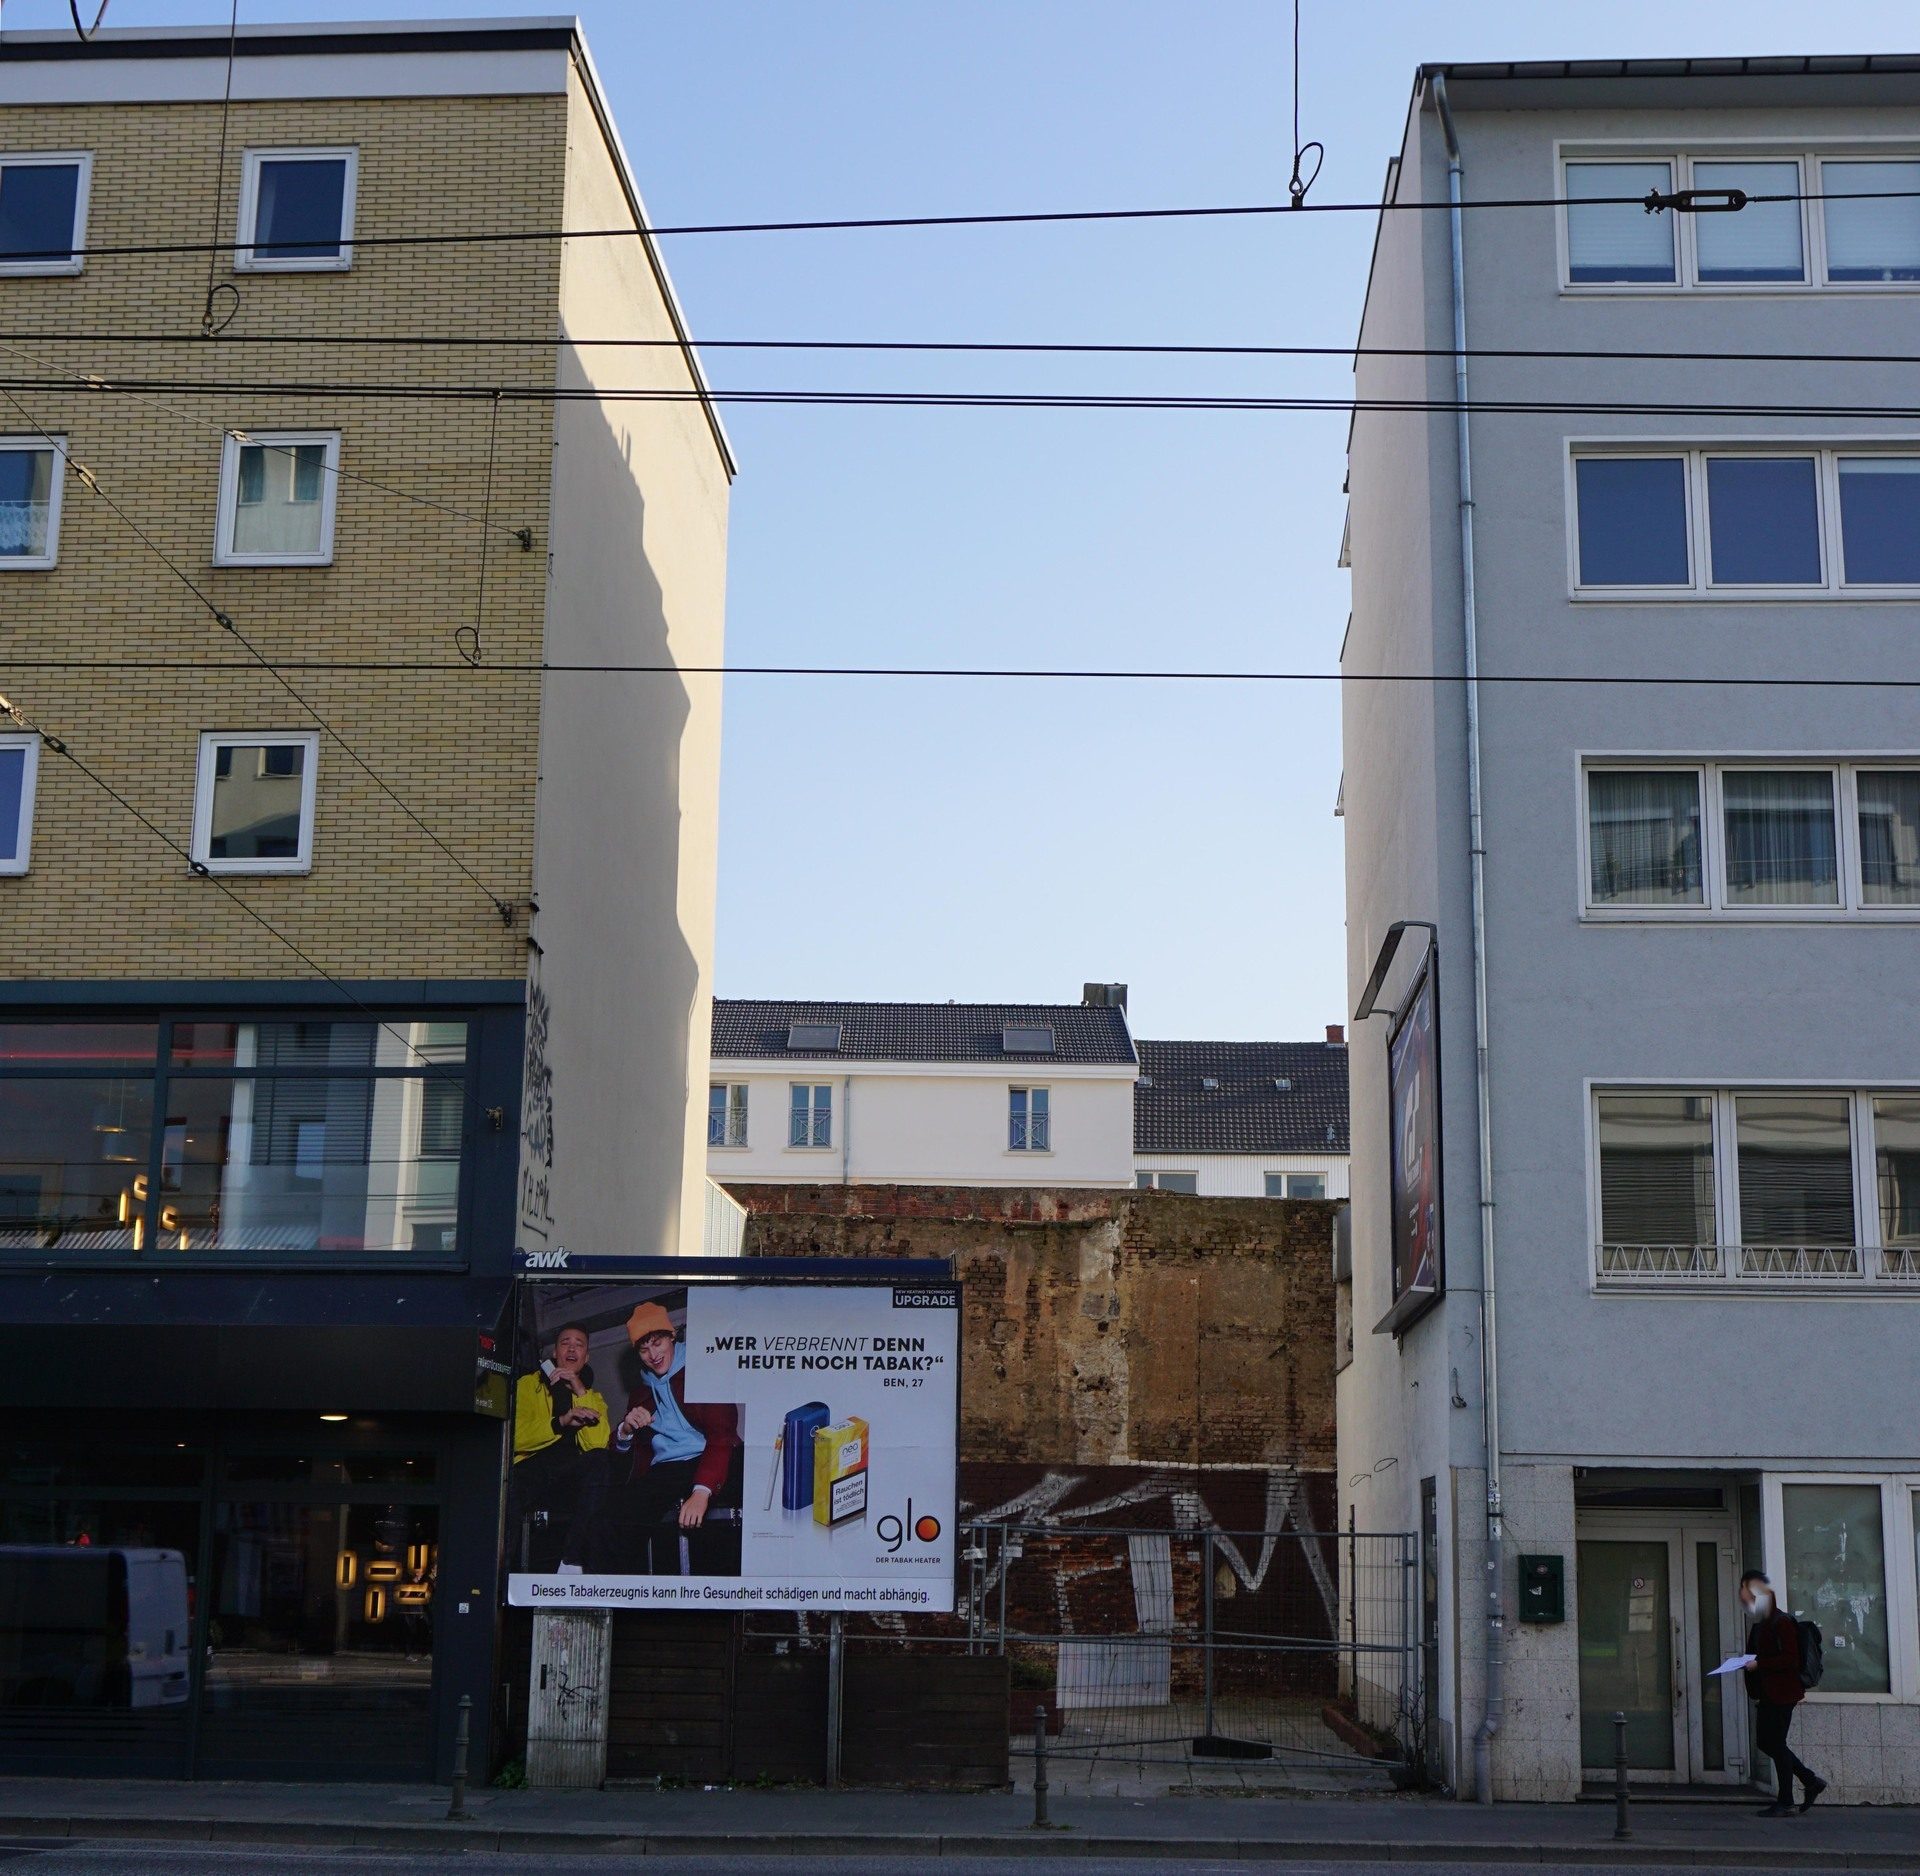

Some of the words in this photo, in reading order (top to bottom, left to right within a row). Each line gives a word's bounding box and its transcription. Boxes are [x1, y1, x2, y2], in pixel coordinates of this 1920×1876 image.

[525, 1246, 570, 1268] awk
[895, 1295, 956, 1306] UPGRADE
[763, 1336, 868, 1351] VERBRENNT
[873, 1337, 925, 1352] DENN
[738, 1355, 796, 1370] HEUTE
[801, 1355, 857, 1370] NOCH
[883, 1378, 909, 1388] BEN,
[911, 1378, 924, 1388] 27
[842, 1442, 859, 1456] neo
[835, 1479, 863, 1496] Rauchen
[834, 1496, 842, 1505] ist
[843, 1488, 864, 1503] tödlich
[876, 1497, 941, 1553] glo
[531, 1584, 566, 1598] Dieses
[569, 1584, 649, 1600] Tabakerzeugnis
[652, 1586, 677, 1599] kann
[680, 1586, 700, 1599] Ihre
[703, 1586, 763, 1600] Gesundheit
[765, 1586, 819, 1602] schädigen
[821, 1587, 842, 1600] und
[844, 1587, 877, 1601] macht
[879, 1588, 930, 1604] abhängig.
